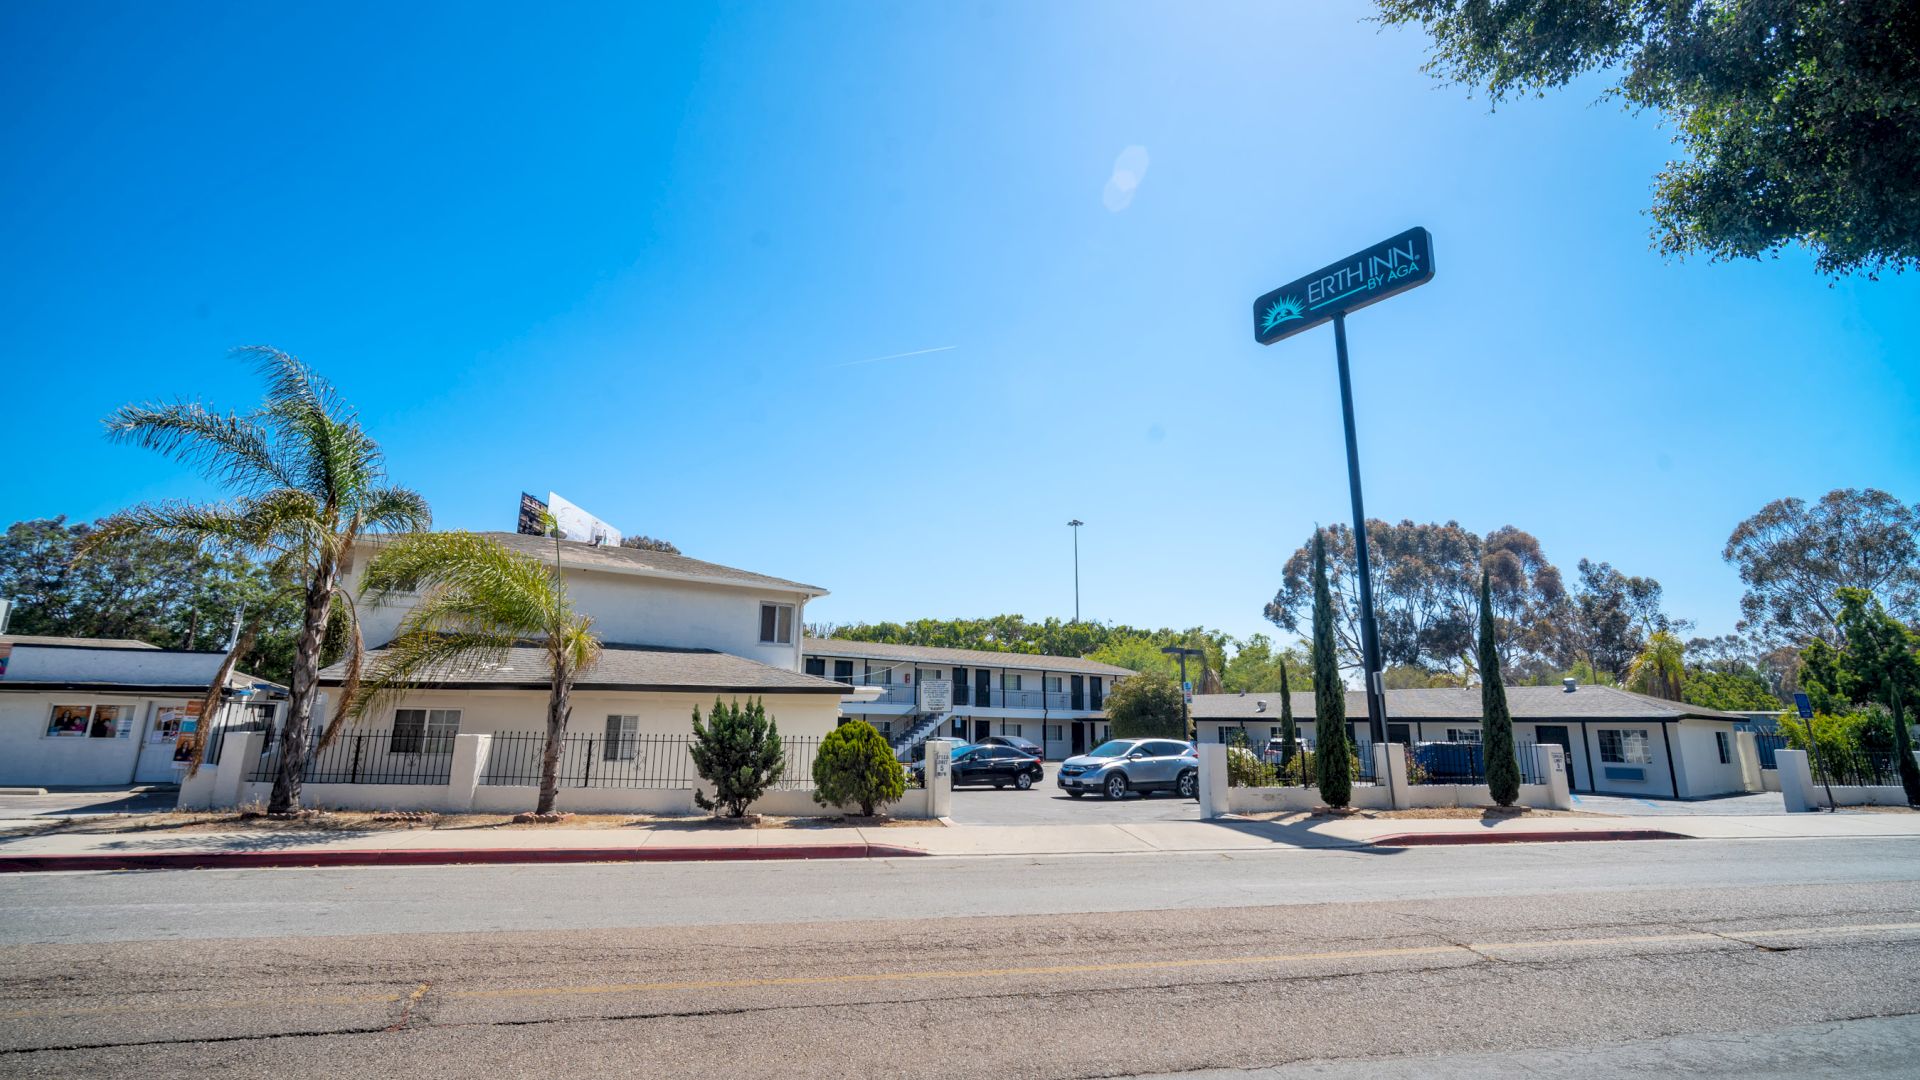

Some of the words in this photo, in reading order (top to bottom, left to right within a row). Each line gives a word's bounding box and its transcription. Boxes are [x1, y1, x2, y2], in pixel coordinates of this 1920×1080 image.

[1308, 262, 1363, 303] ERTH
[1367, 273, 1385, 290] BY
[1387, 262, 1419, 283] AGA
